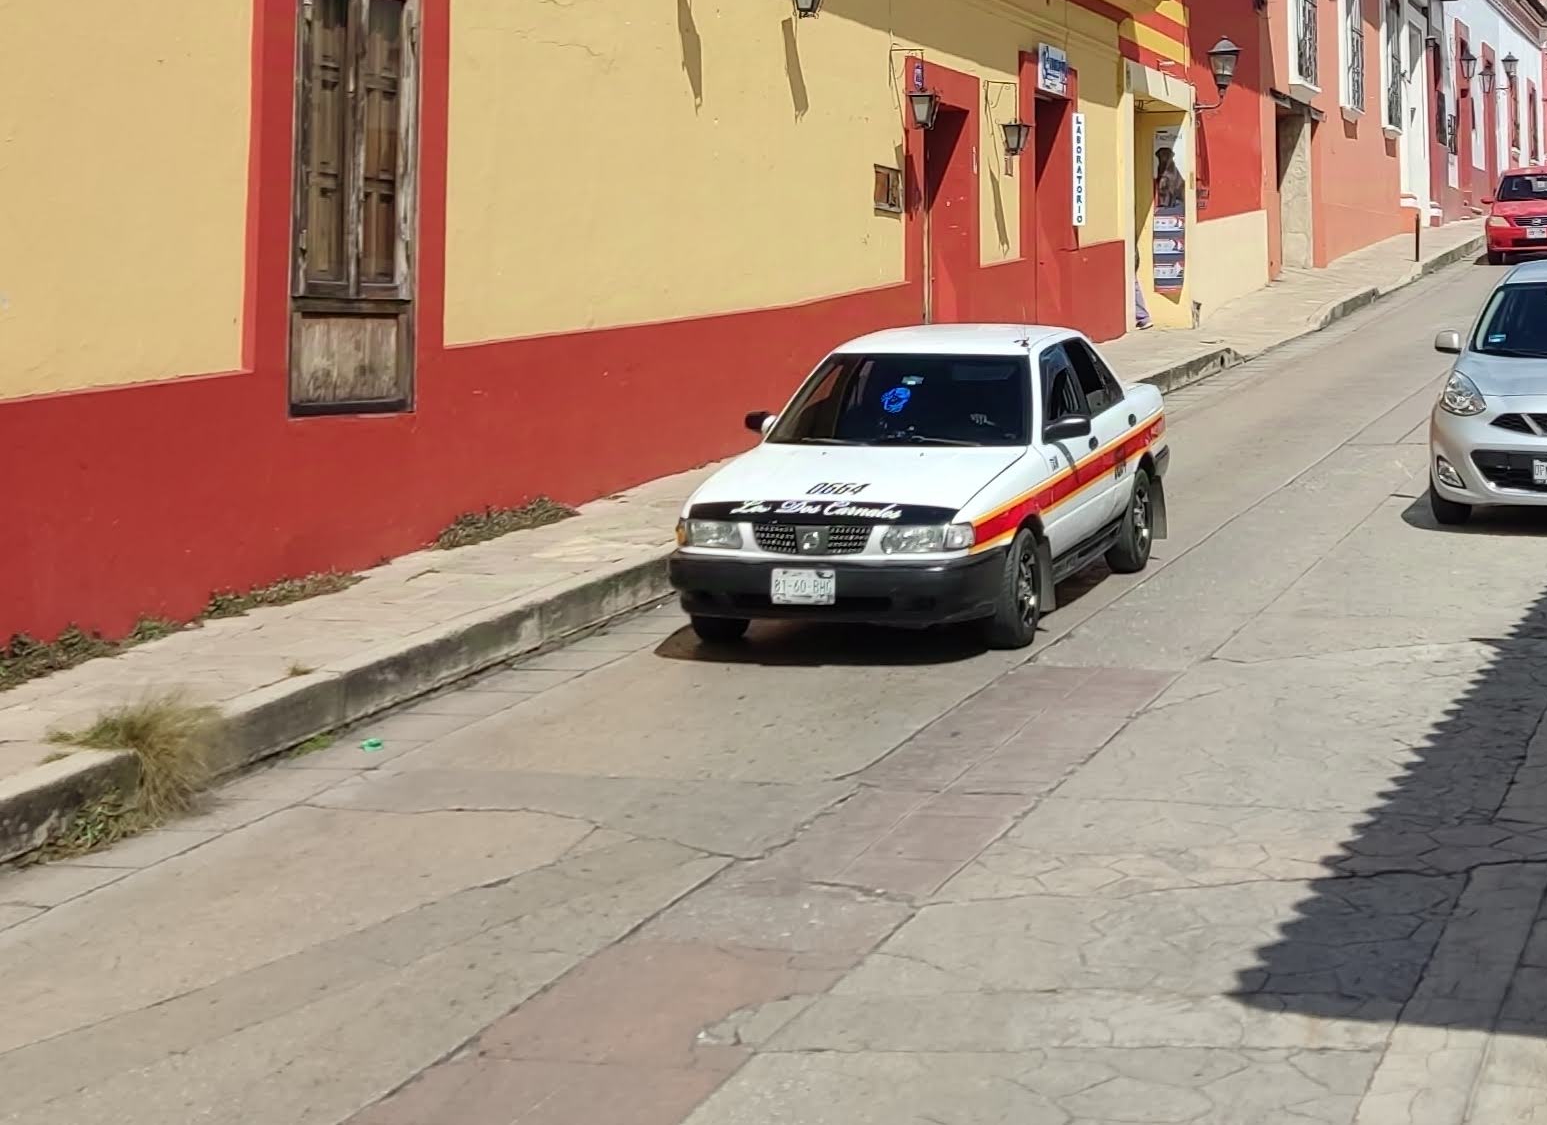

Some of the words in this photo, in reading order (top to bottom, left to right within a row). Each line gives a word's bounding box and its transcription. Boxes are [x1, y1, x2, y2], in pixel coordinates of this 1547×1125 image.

[1075, 115, 1083, 224] LABORATORIO
[806, 482, 871, 495] 0664
[773, 500, 822, 515] Dos
[823, 501, 902, 520] Carnales
